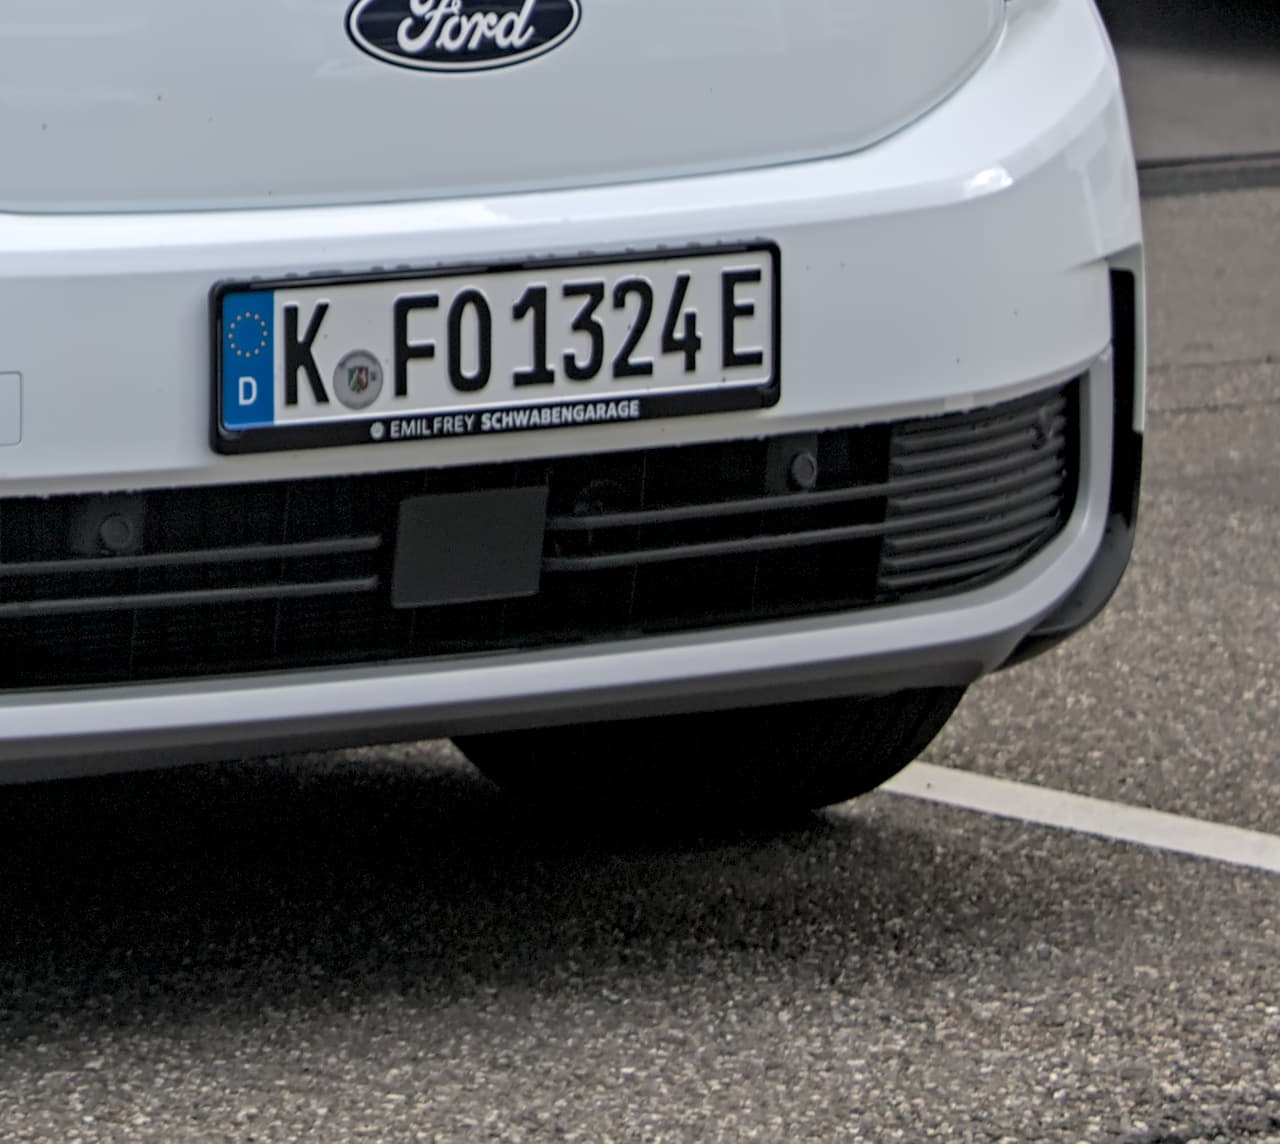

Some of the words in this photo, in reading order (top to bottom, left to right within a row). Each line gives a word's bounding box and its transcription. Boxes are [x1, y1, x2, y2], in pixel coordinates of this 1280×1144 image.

[282, 300, 330, 407] K
[238, 376, 258, 406] D
[390, 420, 431, 438] EMIL
[433, 414, 475, 433] FREY
[480, 399, 640, 431] SCHWABENGARAGE
